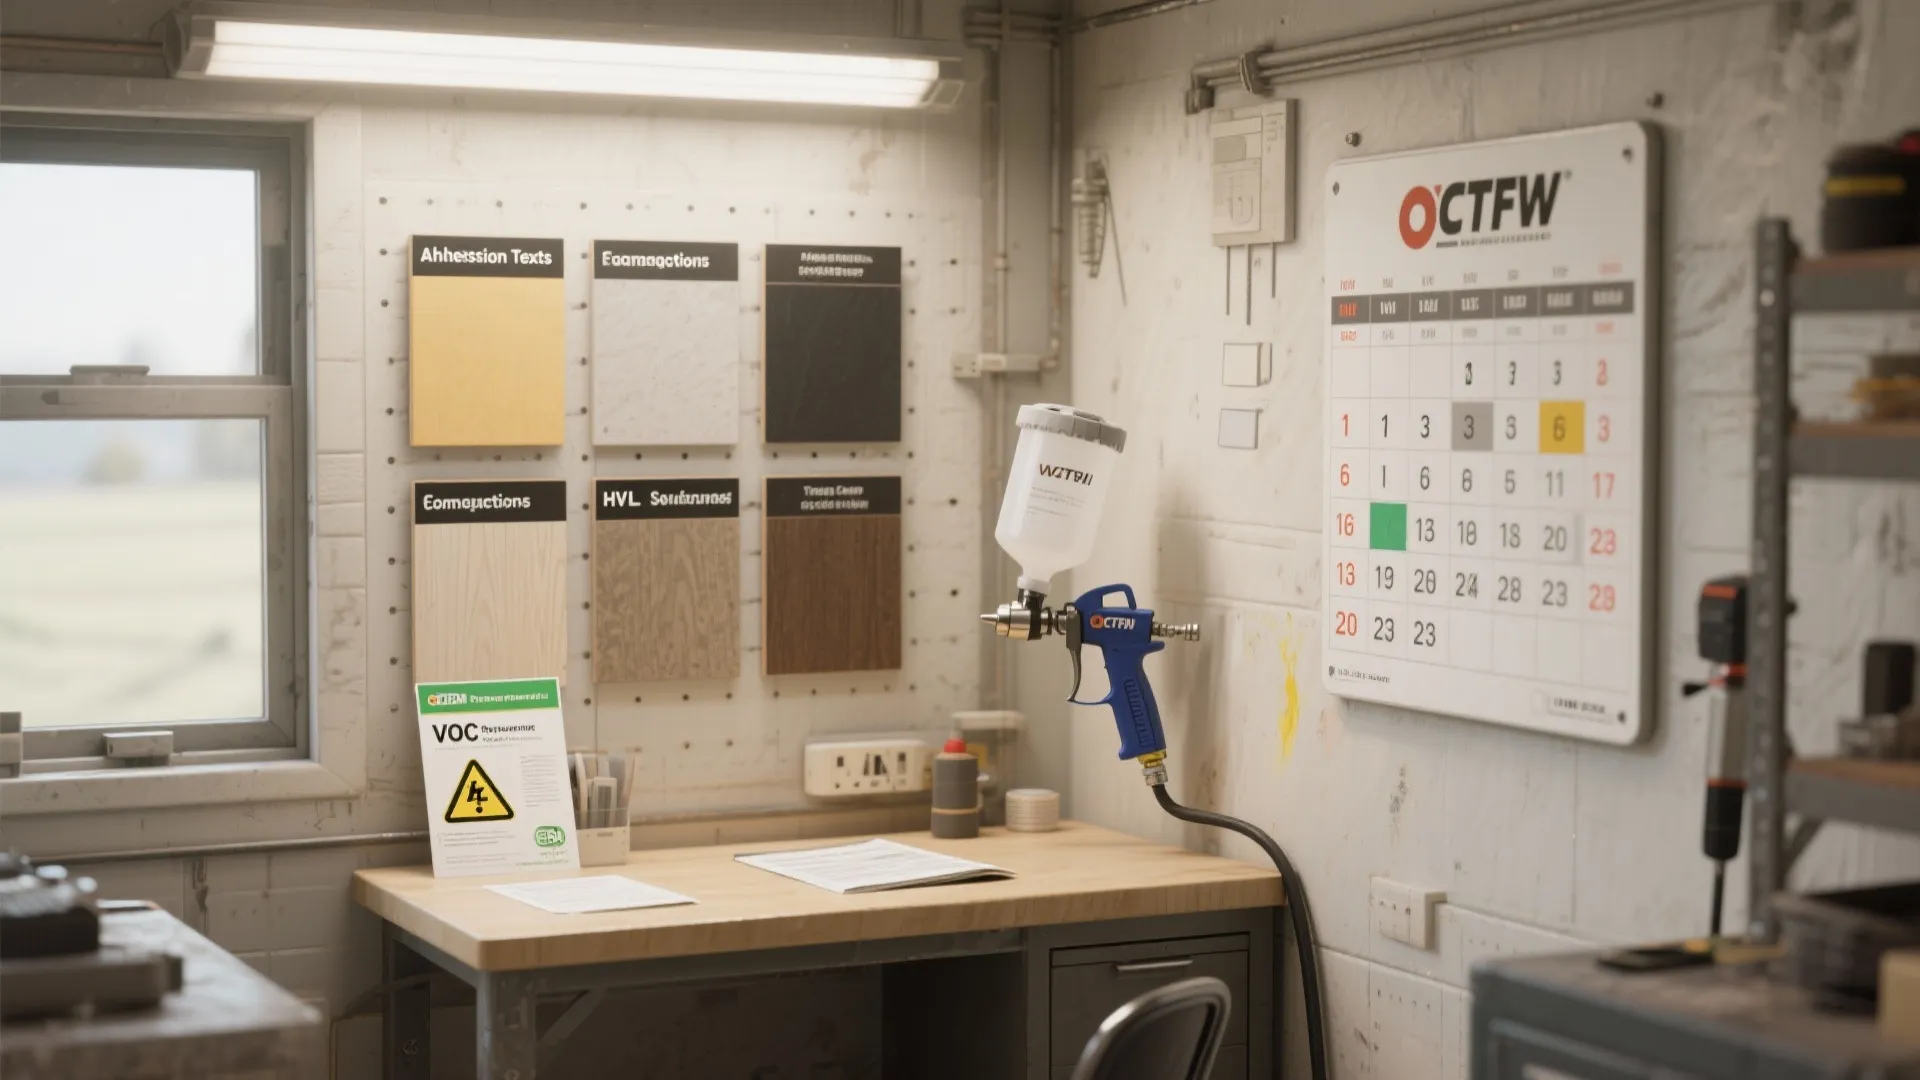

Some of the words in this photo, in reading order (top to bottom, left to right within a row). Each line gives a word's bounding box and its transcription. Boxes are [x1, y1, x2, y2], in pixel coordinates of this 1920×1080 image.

[510, 248, 553, 265] Texts
[1341, 413, 1349, 437] 1
[1381, 414, 1388, 438] 1
[1420, 414, 1430, 439] 3
[1463, 414, 1475, 441] 3
[1552, 414, 1567, 442] 6
[1597, 414, 1611, 444] 3
[1340, 463, 1350, 487] 6
[1419, 465, 1431, 491] 6
[1544, 469, 1564, 498] 11
[1592, 471, 1616, 500] 17
[602, 490, 641, 508] HVL
[1336, 512, 1354, 537] 16
[1415, 517, 1436, 543] 13
[1542, 524, 1568, 553] 20
[1336, 561, 1356, 586] 13
[1375, 565, 1394, 590] 19
[1497, 575, 1522, 604] 28
[1335, 610, 1358, 637] 20
[1413, 620, 1437, 648] 23
[431, 722, 479, 744] VOC
